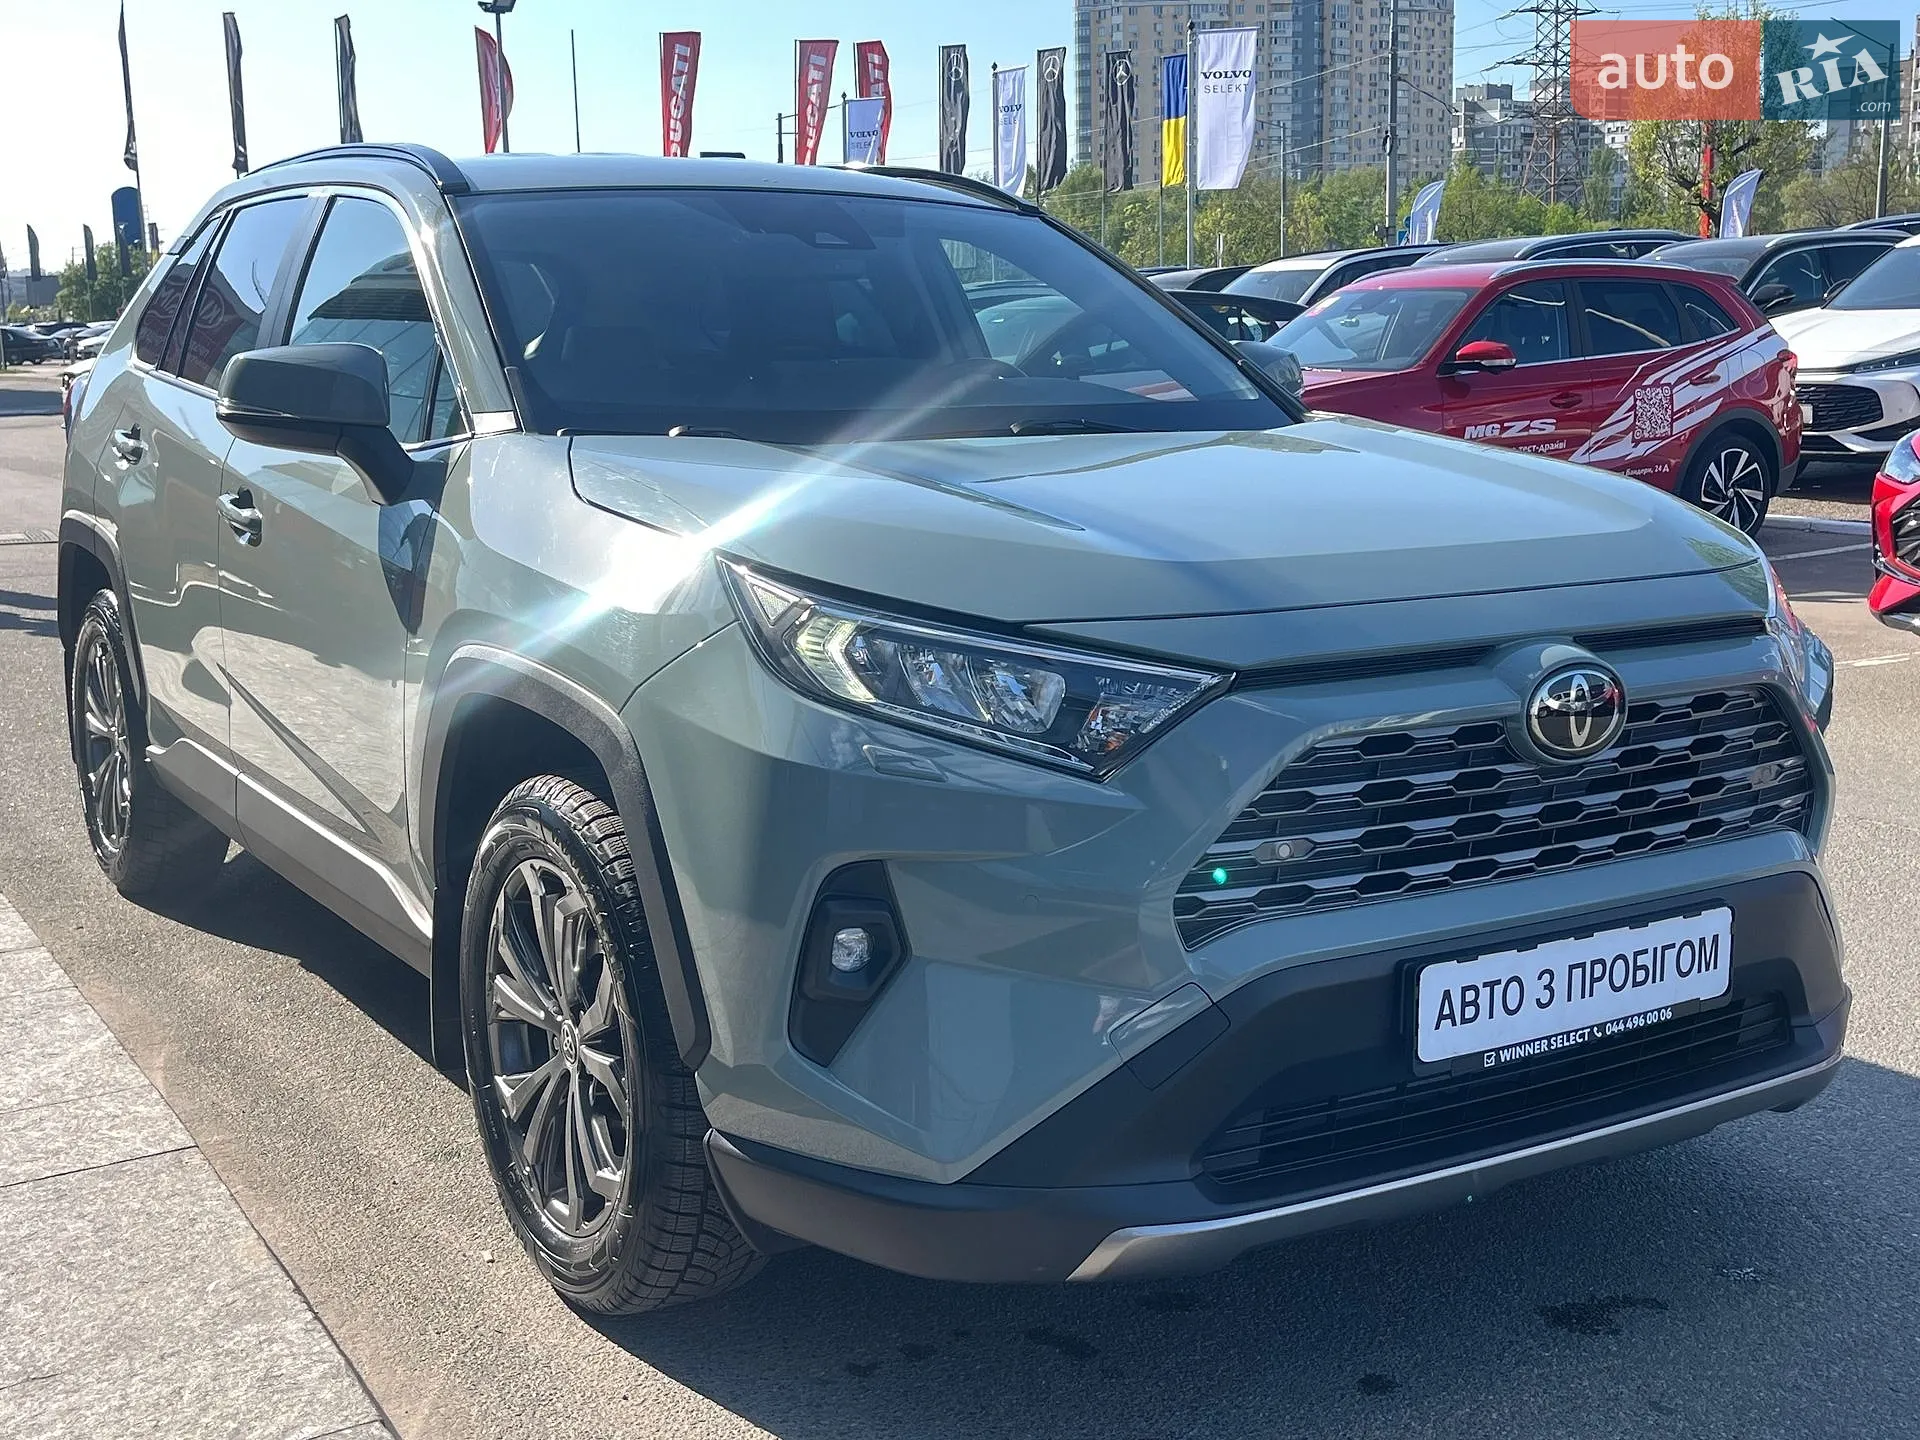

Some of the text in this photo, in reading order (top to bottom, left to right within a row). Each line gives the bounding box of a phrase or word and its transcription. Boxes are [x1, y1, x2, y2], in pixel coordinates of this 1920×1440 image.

[1201, 70, 1252, 79] VOLVO
[1204, 83, 1248, 94] SELEKT
[999, 104, 1022, 113] VOLV
[849, 130, 879, 138] VOLVO
[1464, 418, 1557, 440] MG ZS
[1434, 975, 1525, 1030] АВТО
[1567, 933, 1720, 1002] ПРОБІГОМ
[1500, 1007, 1673, 1063] WINNER SELECT 044 496 00 06
